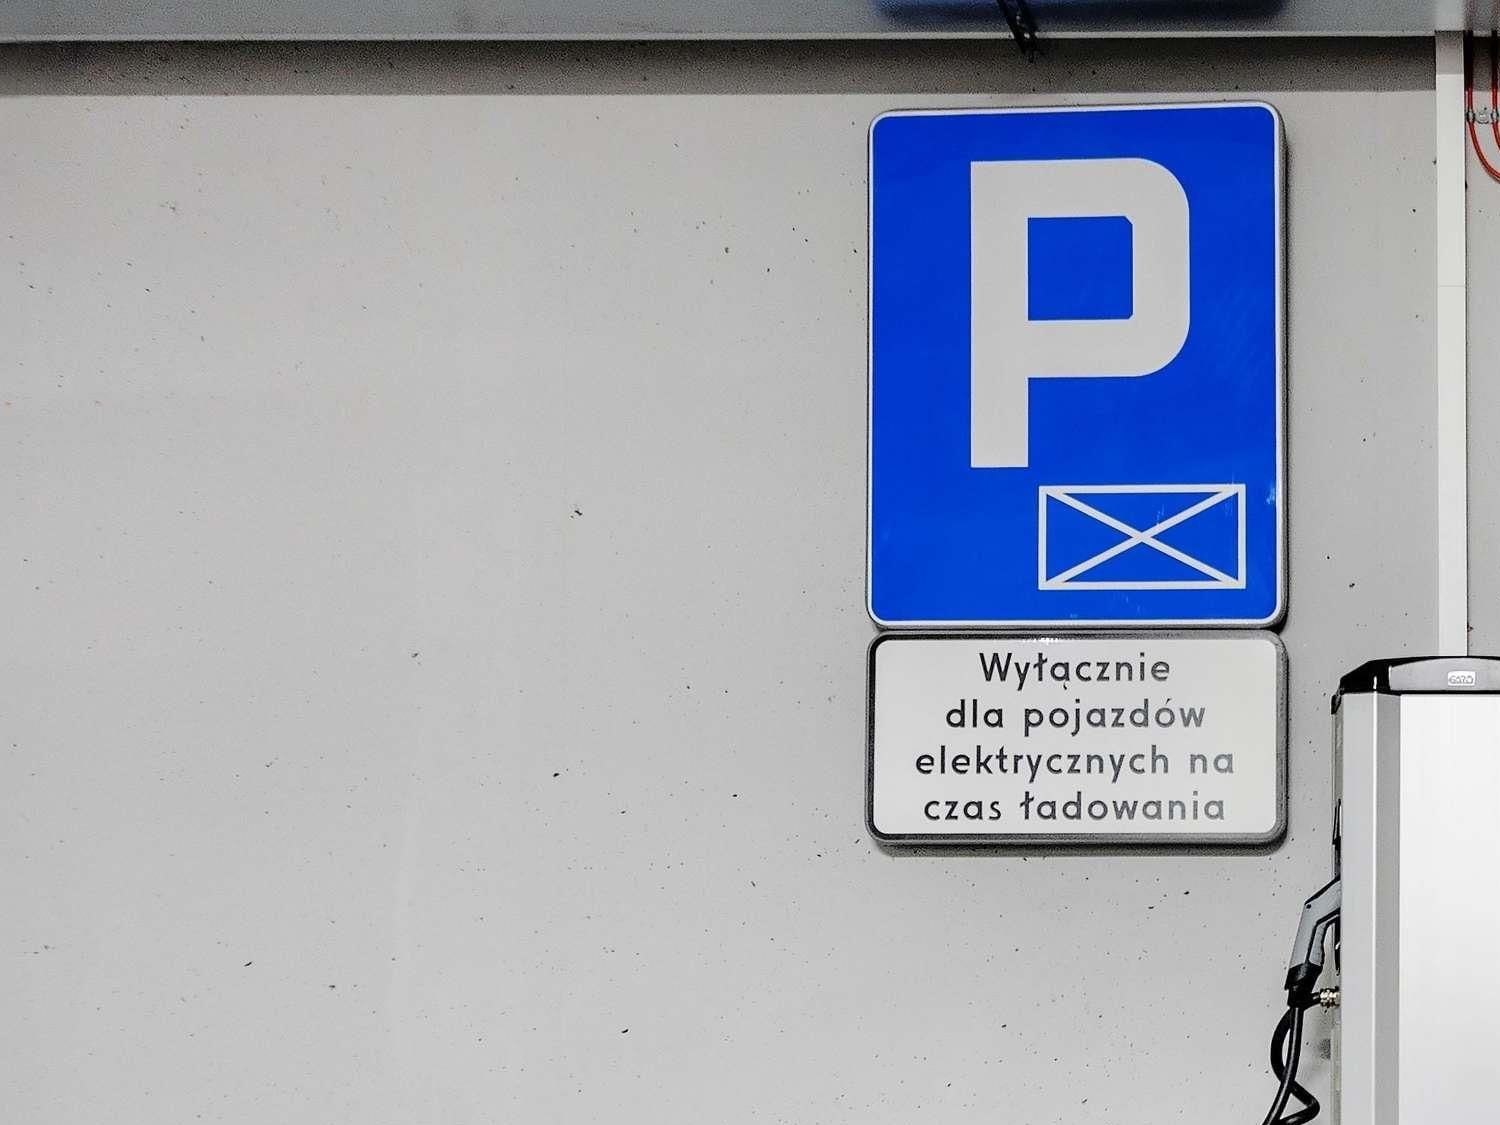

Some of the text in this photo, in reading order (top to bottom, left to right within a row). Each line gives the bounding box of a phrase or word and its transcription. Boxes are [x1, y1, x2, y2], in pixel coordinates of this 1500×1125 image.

[970, 157, 1190, 468] P
[979, 652, 1170, 691] Wyłącznie
[946, 697, 1206, 737] dla pojazdów
[915, 745, 1234, 784] elektrycznych na
[924, 790, 1225, 821] czas ładowania
